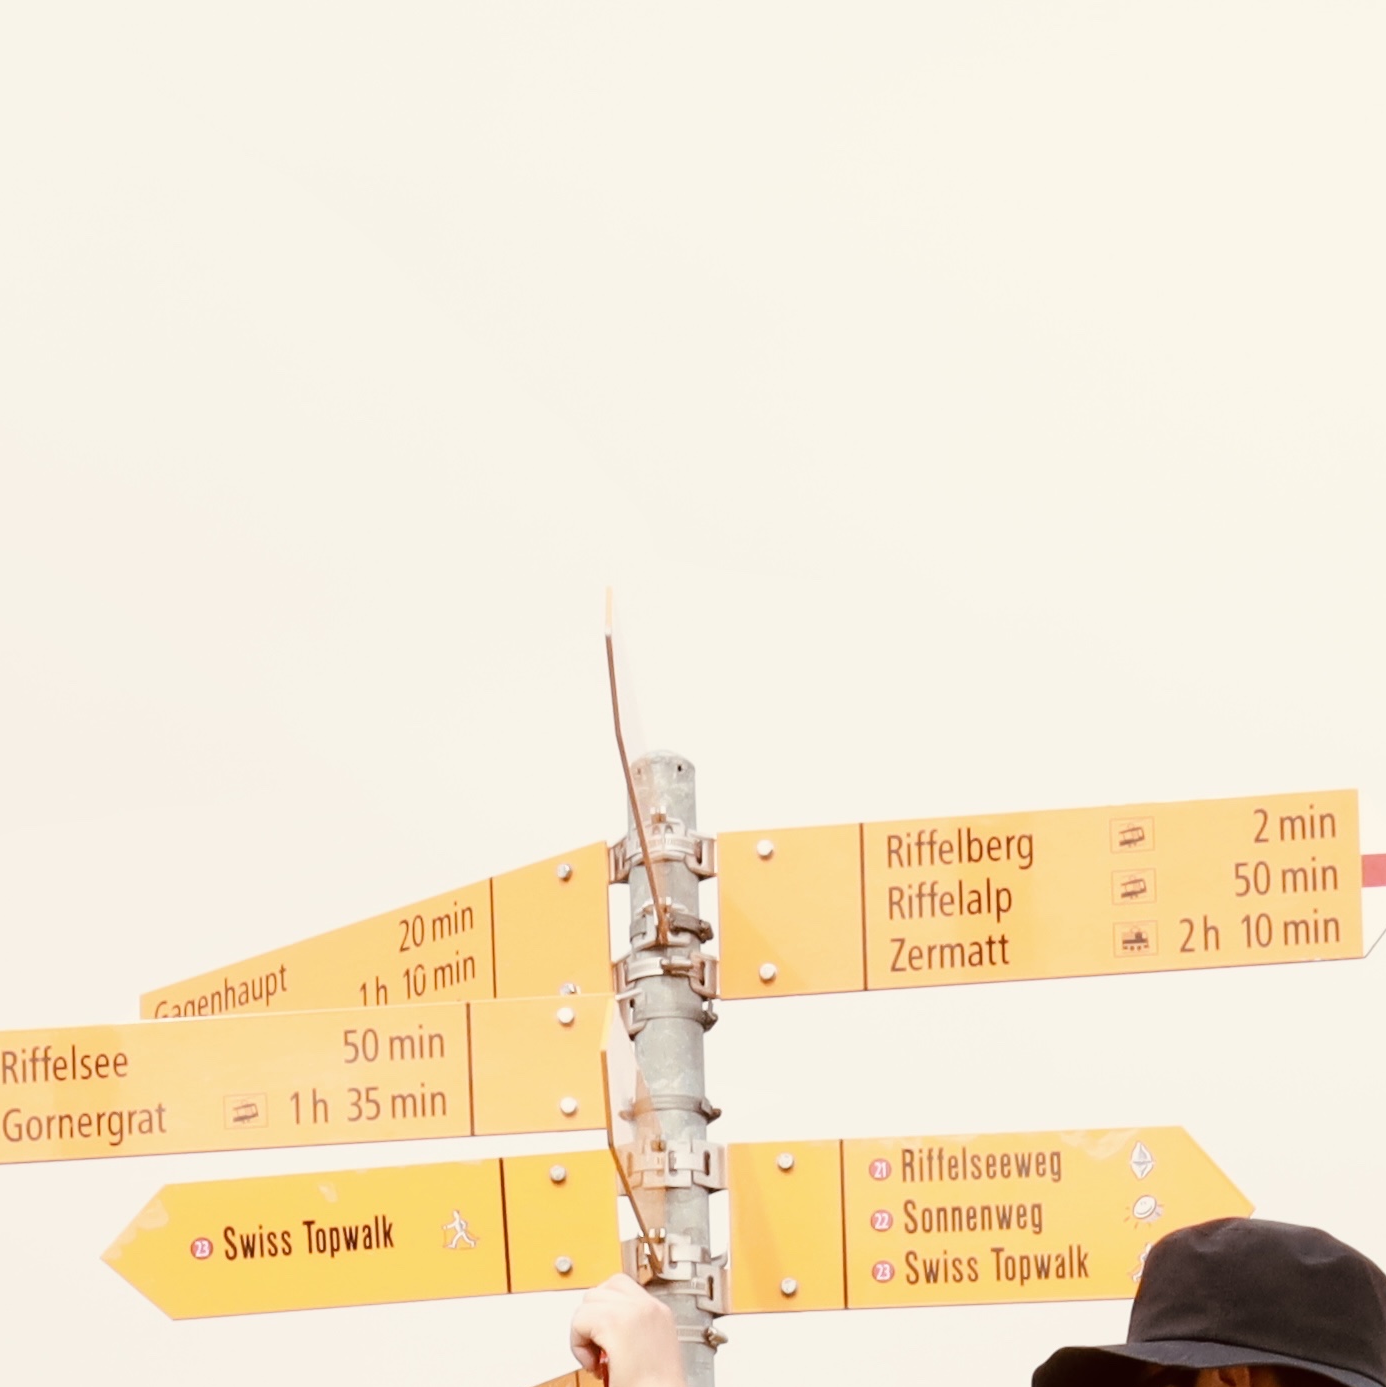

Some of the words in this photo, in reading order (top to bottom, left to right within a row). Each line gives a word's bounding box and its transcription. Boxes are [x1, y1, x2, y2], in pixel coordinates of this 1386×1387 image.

[887, 827, 1034, 869] Riffelberg
[1253, 808, 1269, 844] 2
[1279, 804, 1337, 842] min
[888, 876, 1013, 923] Riffelalp
[1233, 860, 1271, 897] 50
[1281, 856, 1339, 894] min
[399, 915, 425, 952] 20
[432, 901, 474, 941] min
[890, 934, 1010, 973] Zermatt
[1240, 912, 1273, 949] 10
[1283, 909, 1341, 946] min
[403, 964, 426, 1000] 10
[434, 950, 476, 991] min
[2, 1044, 129, 1084] Riffelsee
[343, 1028, 379, 1064] 50
[389, 1024, 445, 1062] min
[2, 1102, 167, 1147] Gornergrat
[346, 1086, 381, 1122] 35
[391, 1083, 447, 1120] min
[874, 1162, 888, 1178] 21
[901, 1147, 1062, 1183] Riffelseeweg
[194, 1240, 211, 1258] 23
[223, 1224, 293, 1261] Swiss
[302, 1214, 395, 1259] Topwalk
[874, 1213, 890, 1230] 22
[903, 1199, 1043, 1235] Sonnenweg
[876, 1264, 891, 1280] 23
[904, 1250, 979, 1285] Swiss
[990, 1244, 1089, 1286] Topwalk
